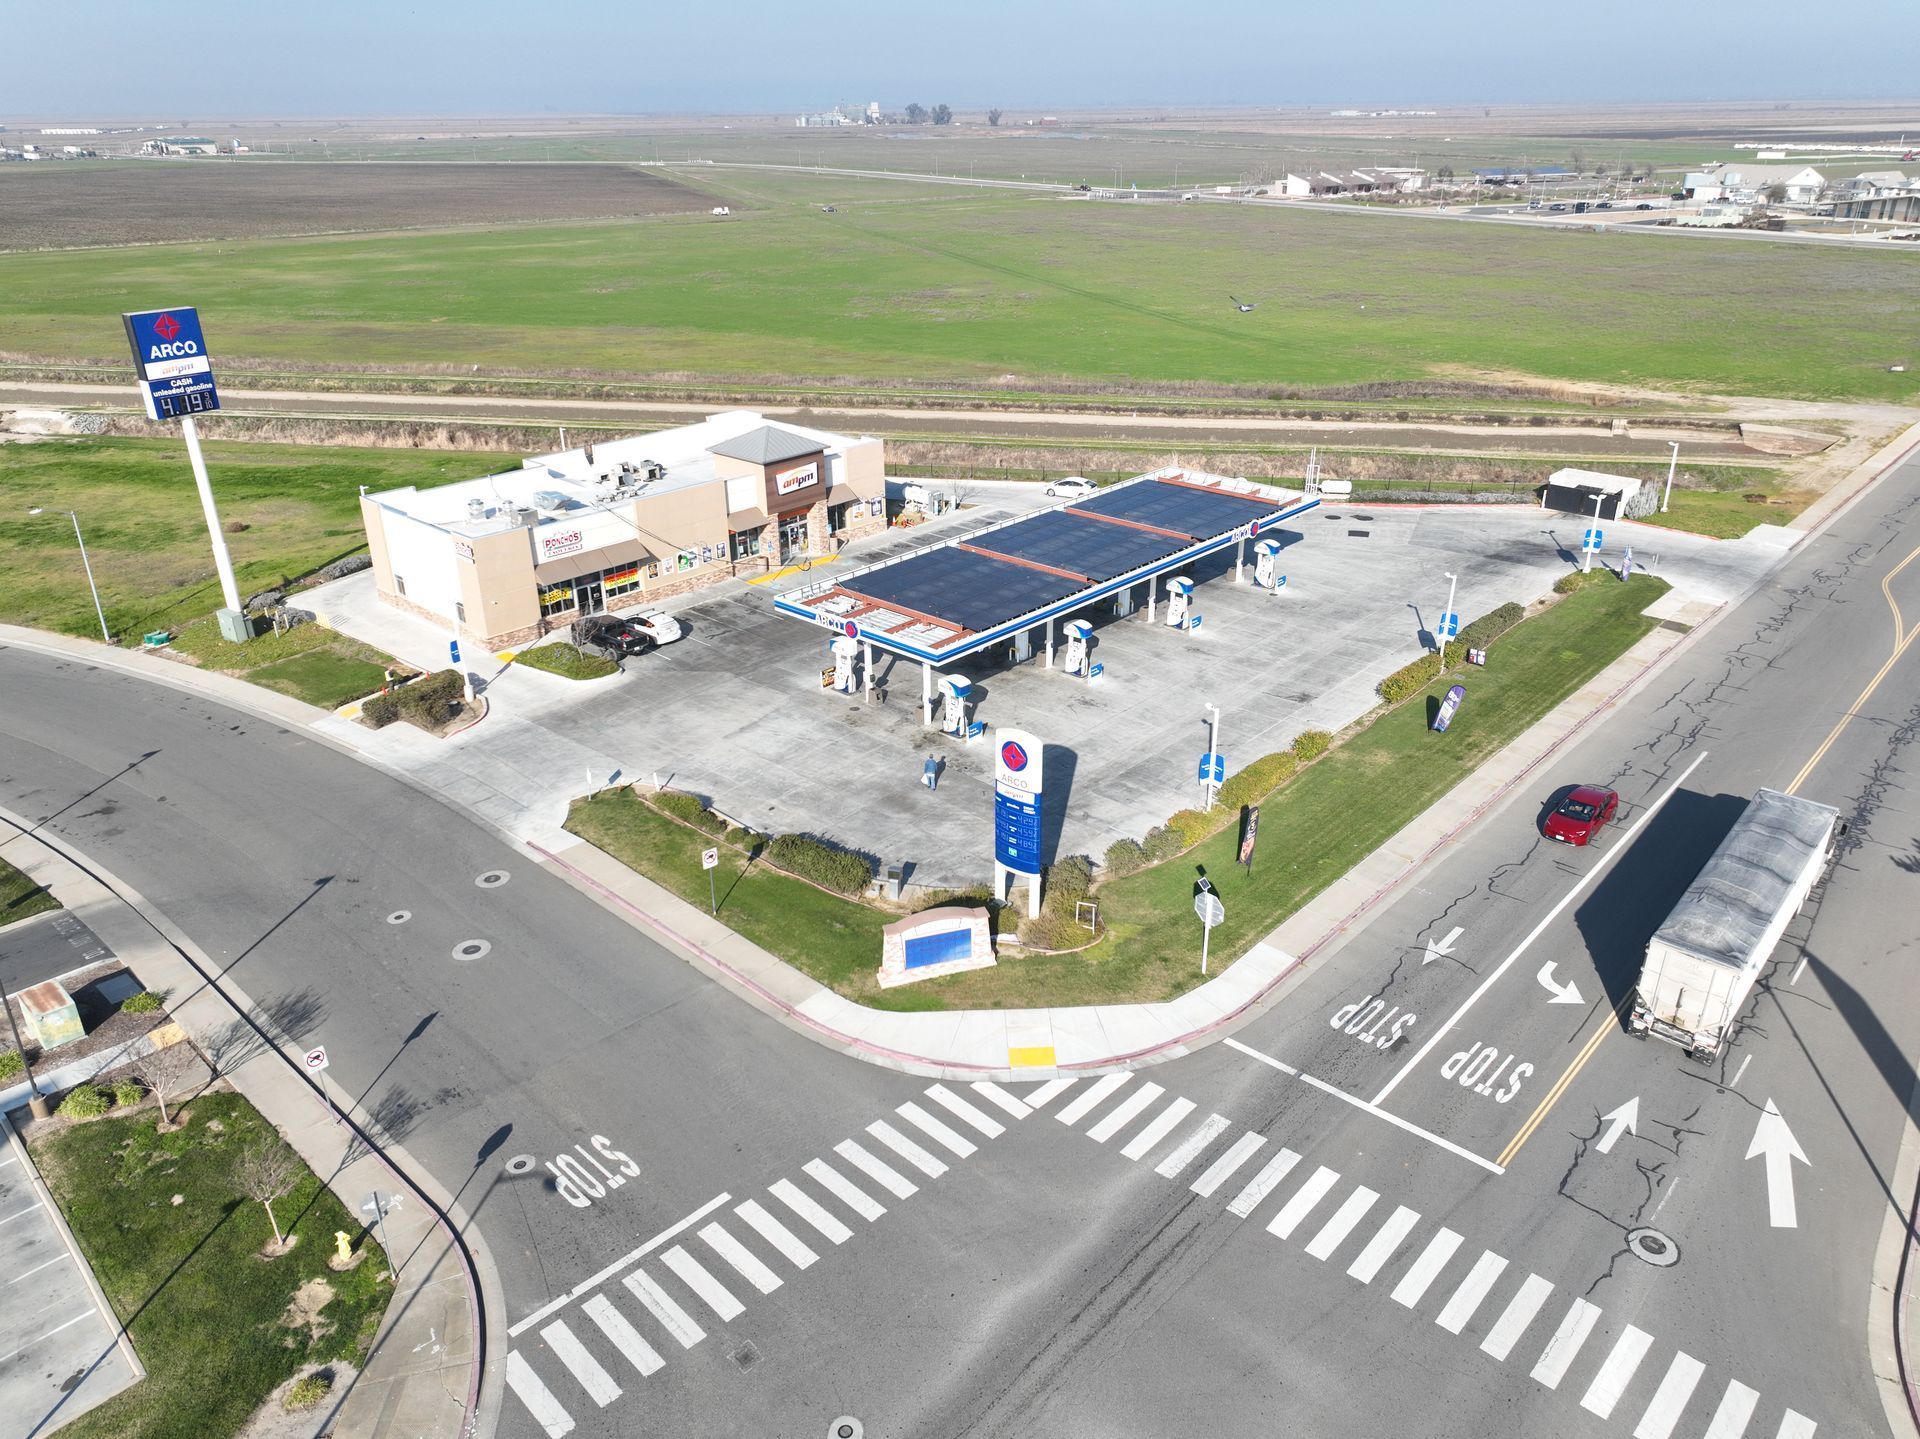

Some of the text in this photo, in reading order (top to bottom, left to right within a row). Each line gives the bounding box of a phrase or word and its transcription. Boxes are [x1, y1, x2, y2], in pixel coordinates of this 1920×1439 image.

[150, 340, 198, 359] ARCO
[162, 363, 194, 374] ampm
[153, 383, 213, 397] unleaded gasoline
[170, 378, 193, 387] CASH
[783, 473, 814, 488] ampm
[545, 532, 580, 549] PONCHOS
[1231, 526, 1249, 543] ARCO
[815, 610, 840, 630] ARCO
[1001, 773, 1028, 789] ARCO
[1330, 995, 1417, 1049] STOP
[1441, 1041, 1534, 1104] STOP
[544, 1134, 641, 1208] STOP
